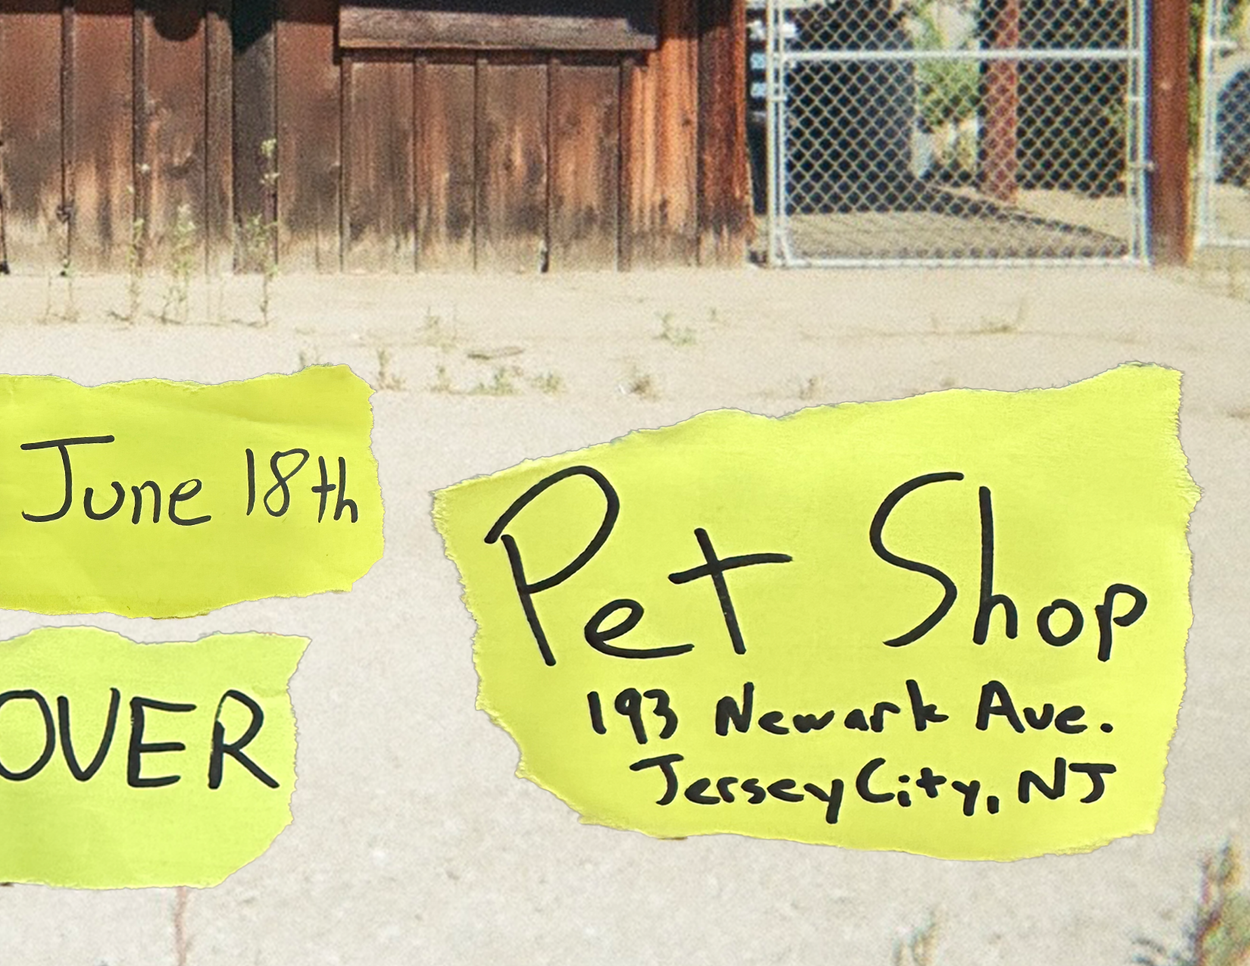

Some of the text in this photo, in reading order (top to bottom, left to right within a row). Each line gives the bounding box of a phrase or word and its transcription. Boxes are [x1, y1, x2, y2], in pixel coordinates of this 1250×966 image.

[20, 434, 213, 526] June
[245, 448, 360, 524] 18th
[483, 464, 1149, 668] Pet Shop
[586, 680, 1115, 746] 193 Newark Ave.
[629, 752, 1118, 826] Jersey City, NJ
